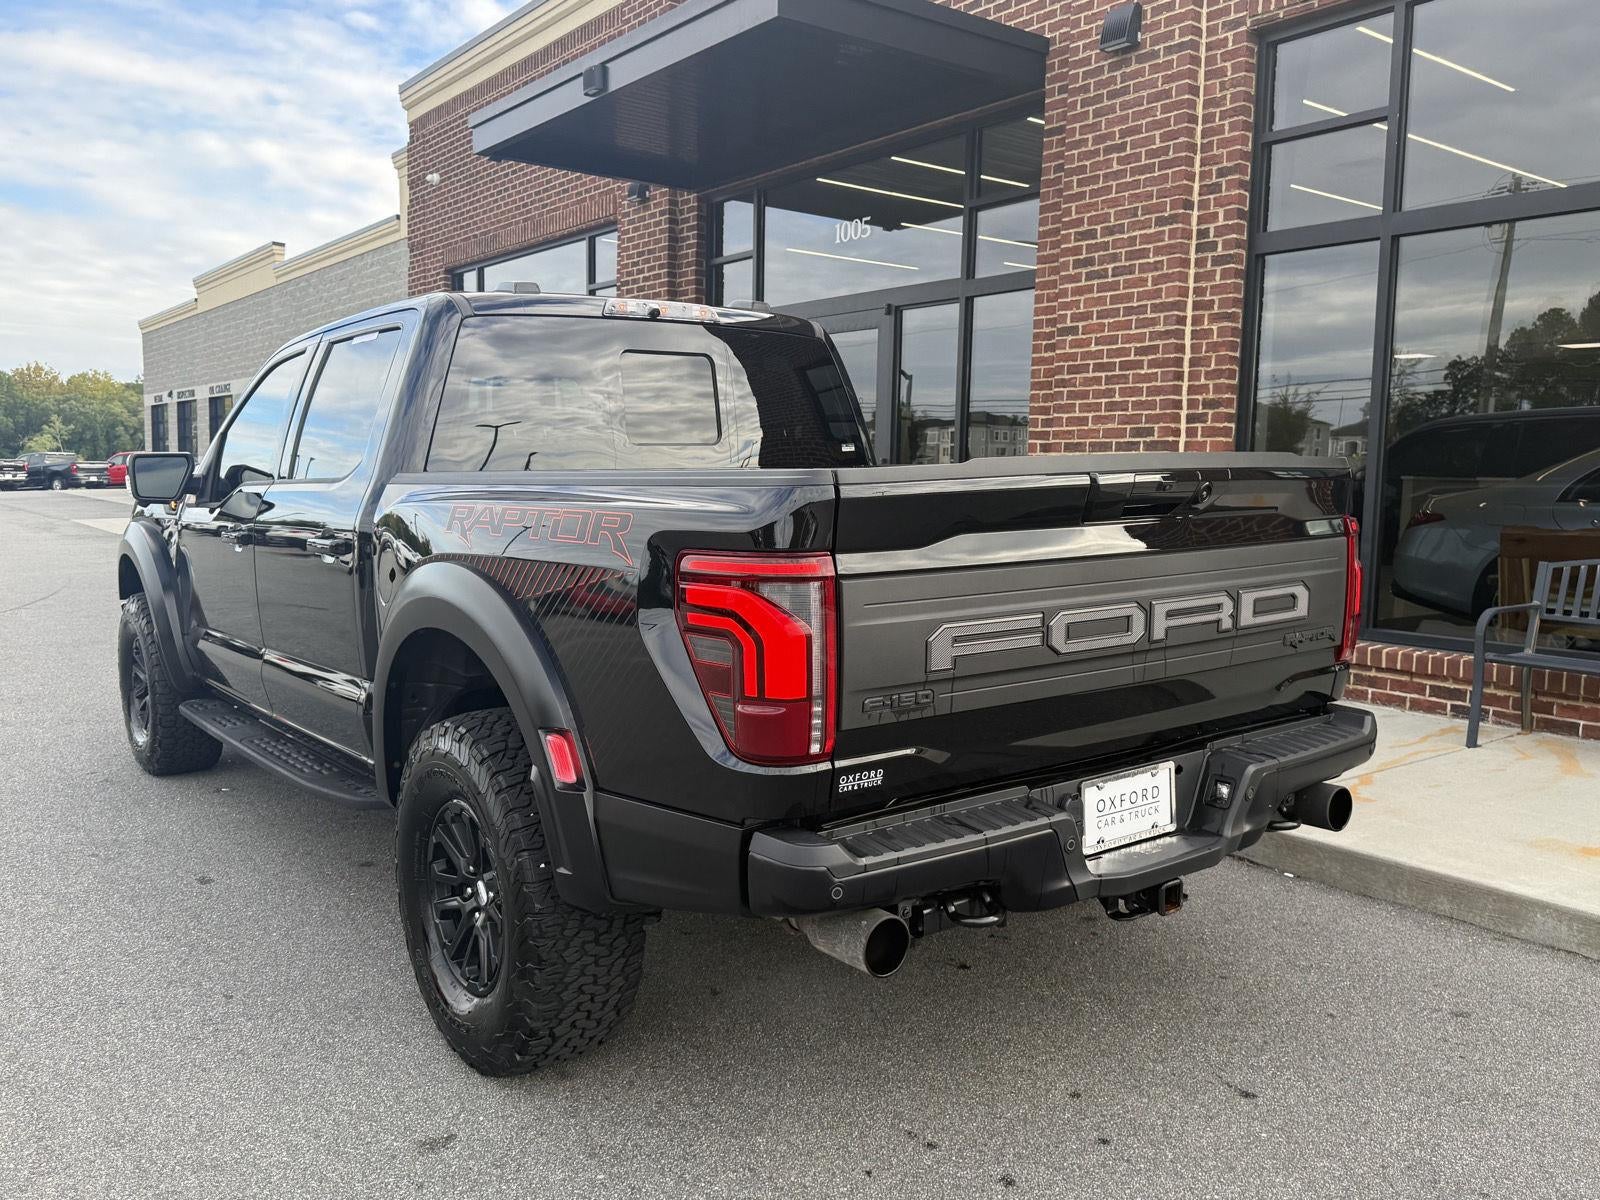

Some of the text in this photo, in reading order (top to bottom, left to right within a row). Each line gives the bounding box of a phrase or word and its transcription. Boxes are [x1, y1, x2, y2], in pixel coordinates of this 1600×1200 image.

[834, 216, 872, 244] 1005
[445, 504, 635, 567] RAPTOR
[925, 579, 1311, 674] FORD
[838, 784, 853, 793] CAR
[860, 779, 882, 790] TRUCK
[839, 769, 884, 785] OXFORD
[1096, 785, 1160, 813] OXFORD
[1096, 804, 1160, 830] CAR & TRUCK
